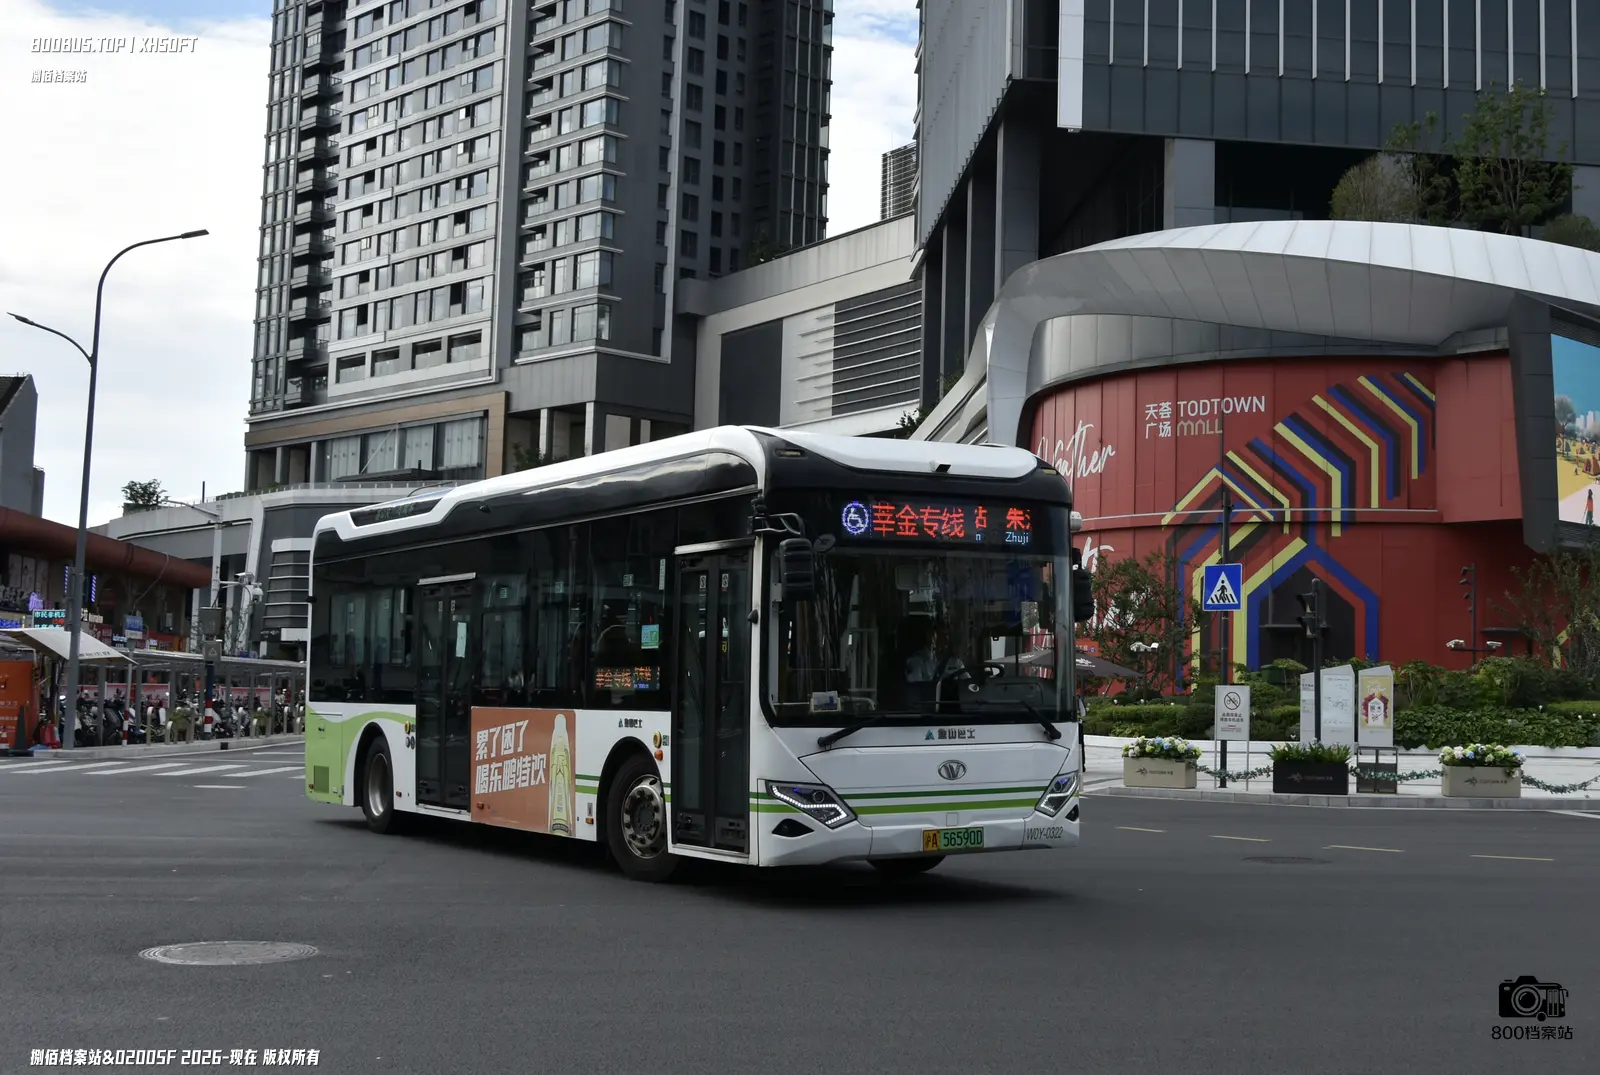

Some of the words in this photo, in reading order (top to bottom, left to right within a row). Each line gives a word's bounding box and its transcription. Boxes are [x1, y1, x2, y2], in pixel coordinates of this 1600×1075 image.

[1145, 401, 1172, 420] 天荟
[1176, 395, 1266, 418] TODTOWN
[1145, 421, 1172, 440] 广场
[872, 502, 965, 538] 莘金专线
[475, 720, 529, 761] 累了困了
[475, 753, 546, 795] 喝东鹏特饮
